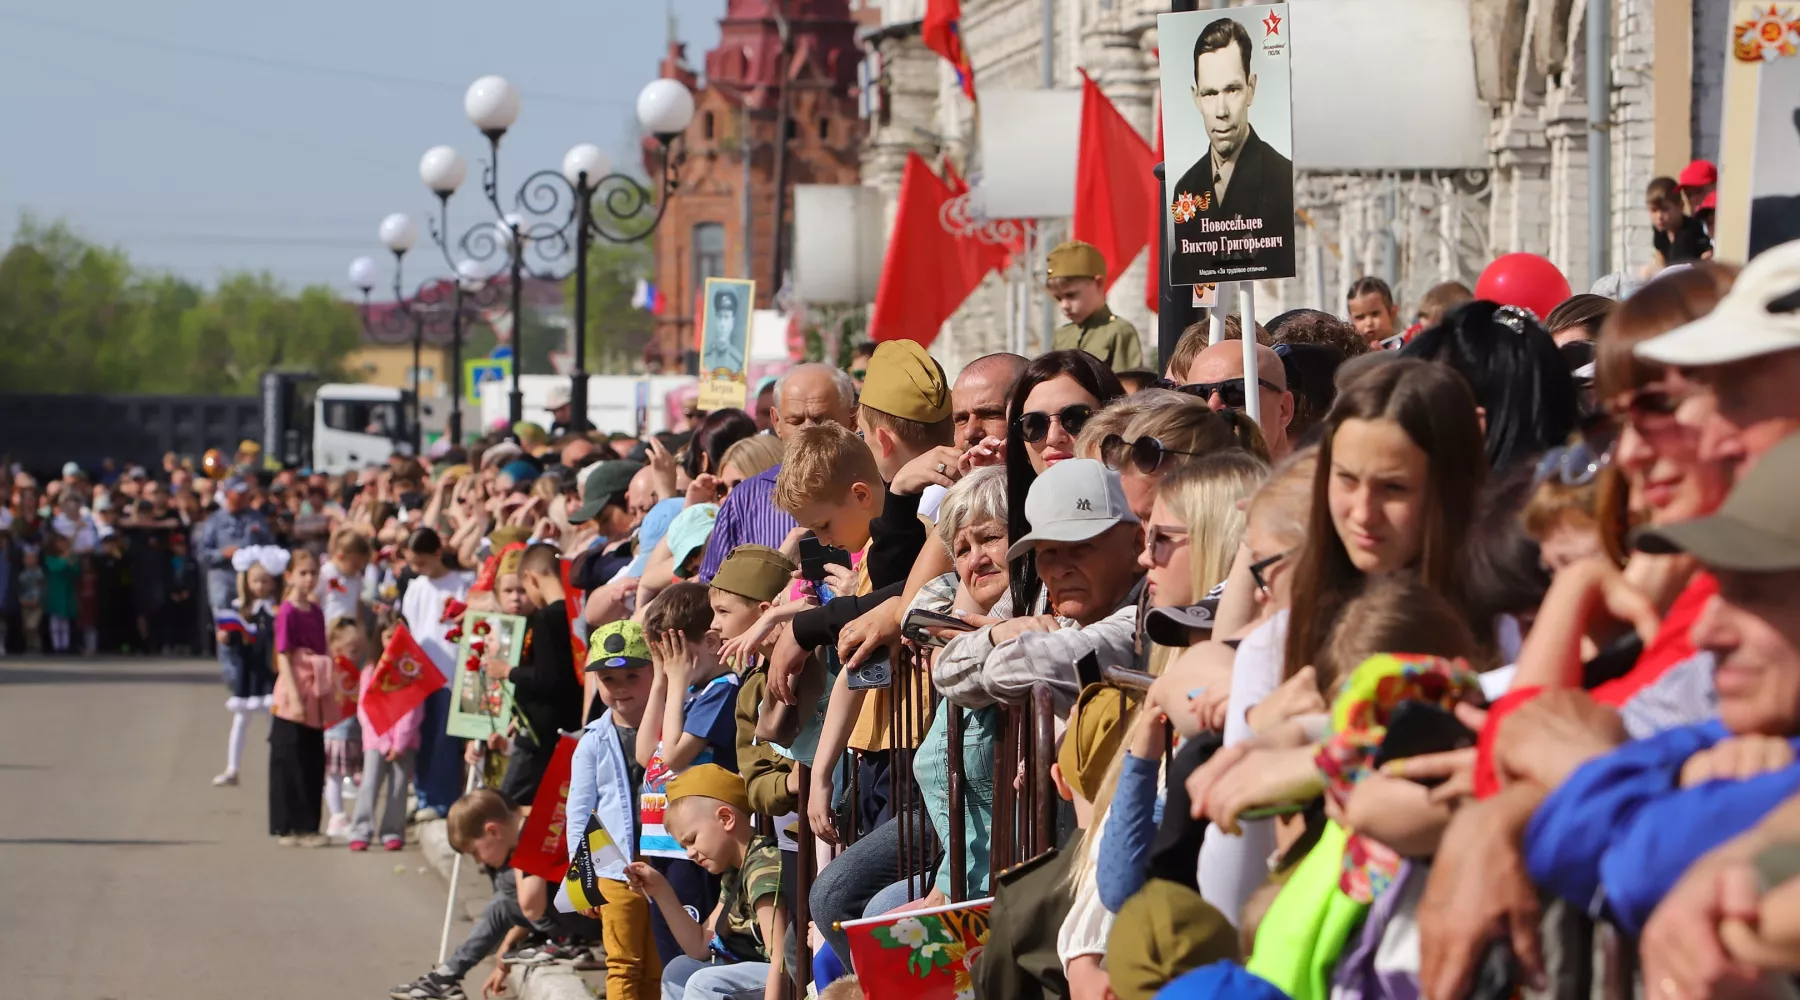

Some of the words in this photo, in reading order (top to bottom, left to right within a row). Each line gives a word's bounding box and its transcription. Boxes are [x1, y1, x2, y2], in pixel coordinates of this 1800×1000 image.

[1200, 217, 1263, 233] Новосельцев
[1181, 239, 1218, 256] Виктор
[1220, 236, 1283, 254] Григорьевич
